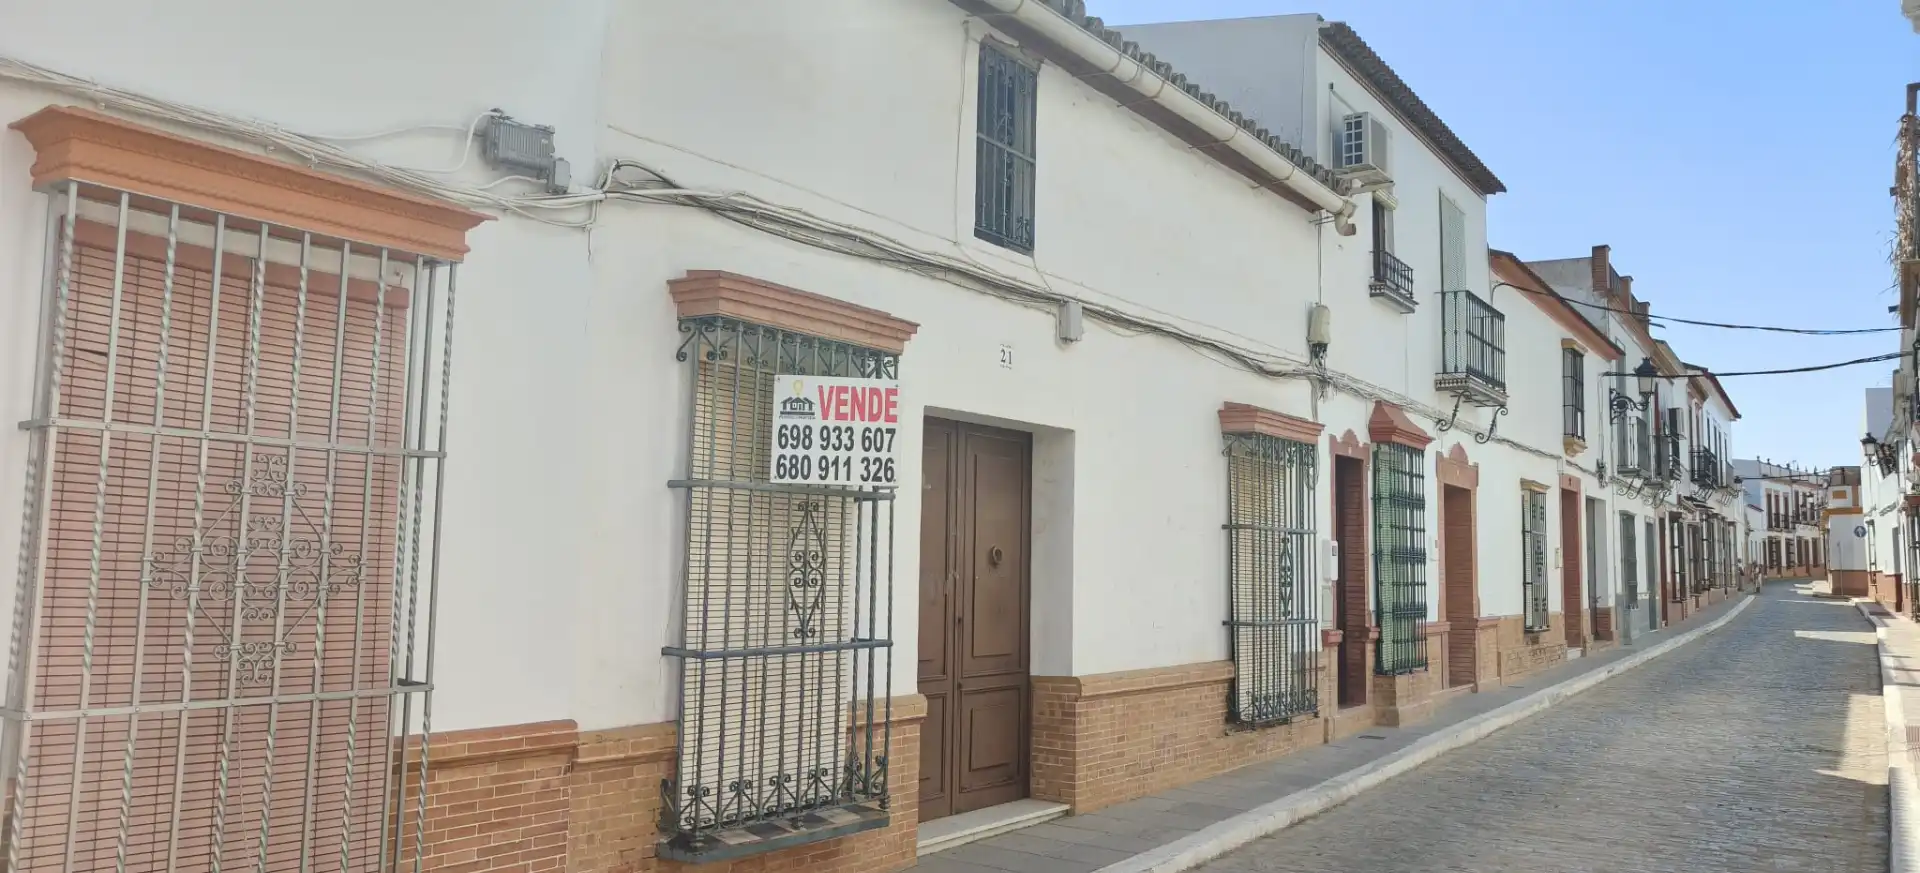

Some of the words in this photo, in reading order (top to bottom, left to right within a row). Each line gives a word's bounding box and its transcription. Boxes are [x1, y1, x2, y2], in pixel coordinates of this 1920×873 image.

[1000, 348, 1012, 365] 21
[817, 385, 898, 423] VENDE
[777, 424, 813, 450] 698
[819, 425, 855, 451] 933
[861, 427, 896, 453] 607
[776, 454, 812, 480] 680
[818, 455, 852, 481] 911
[859, 456, 895, 483] 326
